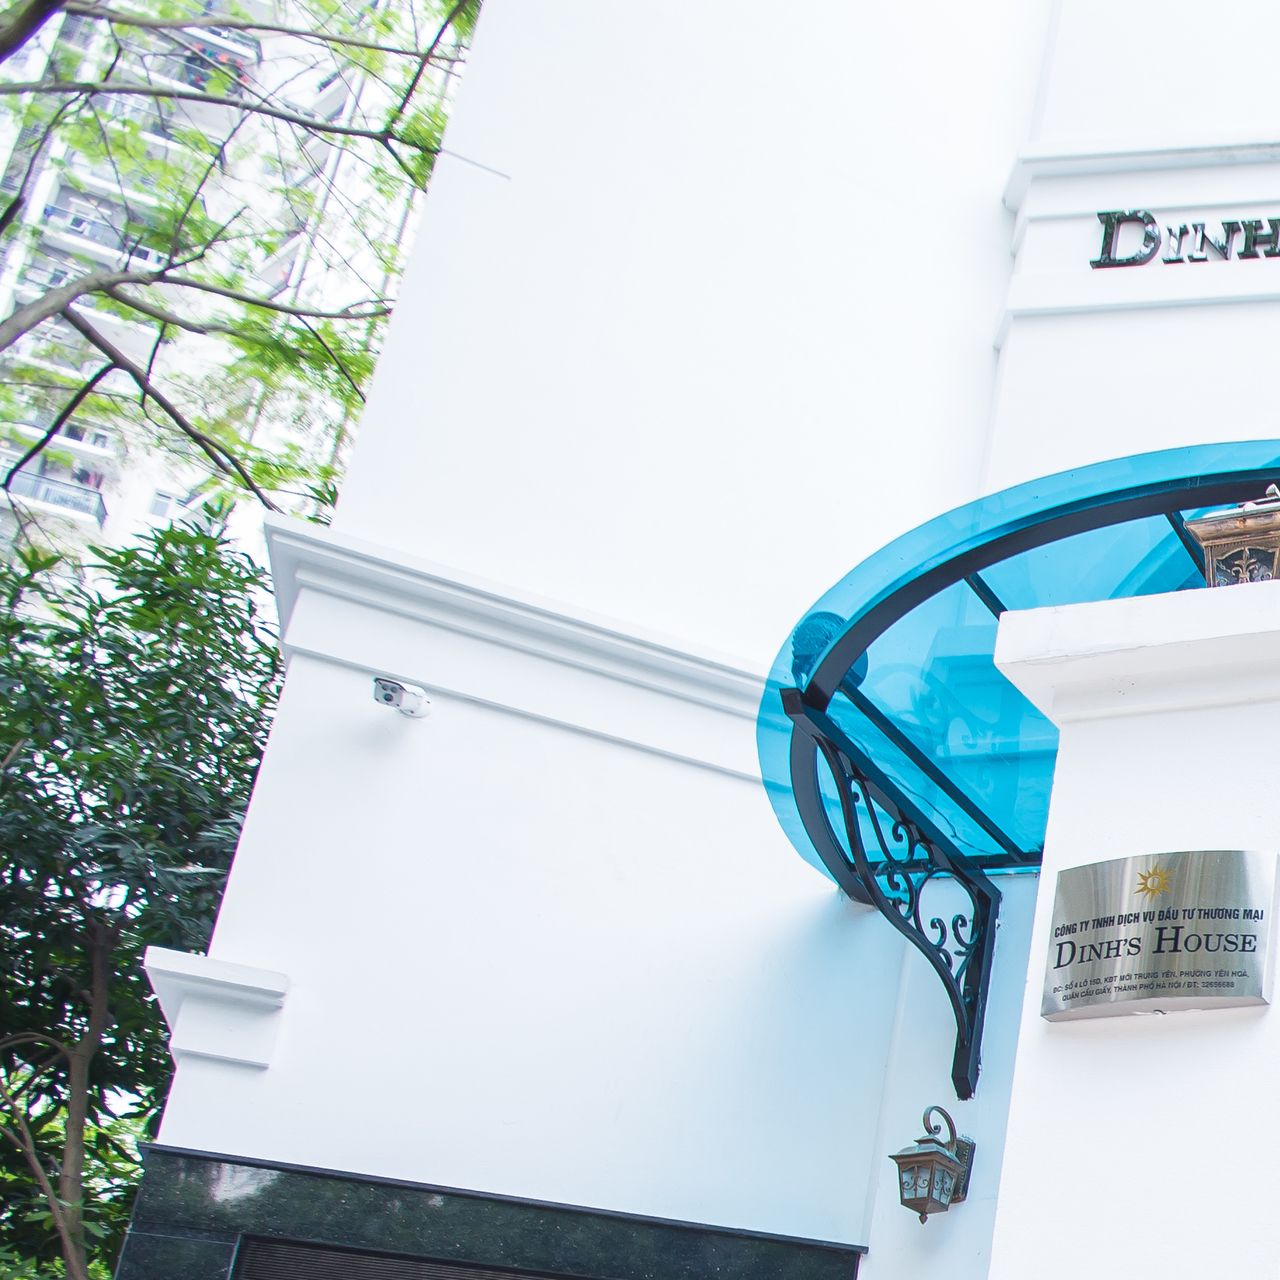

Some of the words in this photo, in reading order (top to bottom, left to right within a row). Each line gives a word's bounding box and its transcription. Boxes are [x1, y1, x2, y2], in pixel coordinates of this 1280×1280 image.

[1054, 923, 1077, 938] CÔNG
[1079, 919, 1090, 932] TY
[1091, 915, 1115, 930] TNHH
[1117, 911, 1140, 927] DỊCH
[1142, 910, 1156, 924] VỤ
[1181, 907, 1197, 920] TƯ
[1197, 907, 1240, 920] THƯƠNG
[1242, 909, 1264, 923] MẠI
[1152, 926, 1257, 953] HOUSE
[1134, 971, 1159, 980] TRUNG
